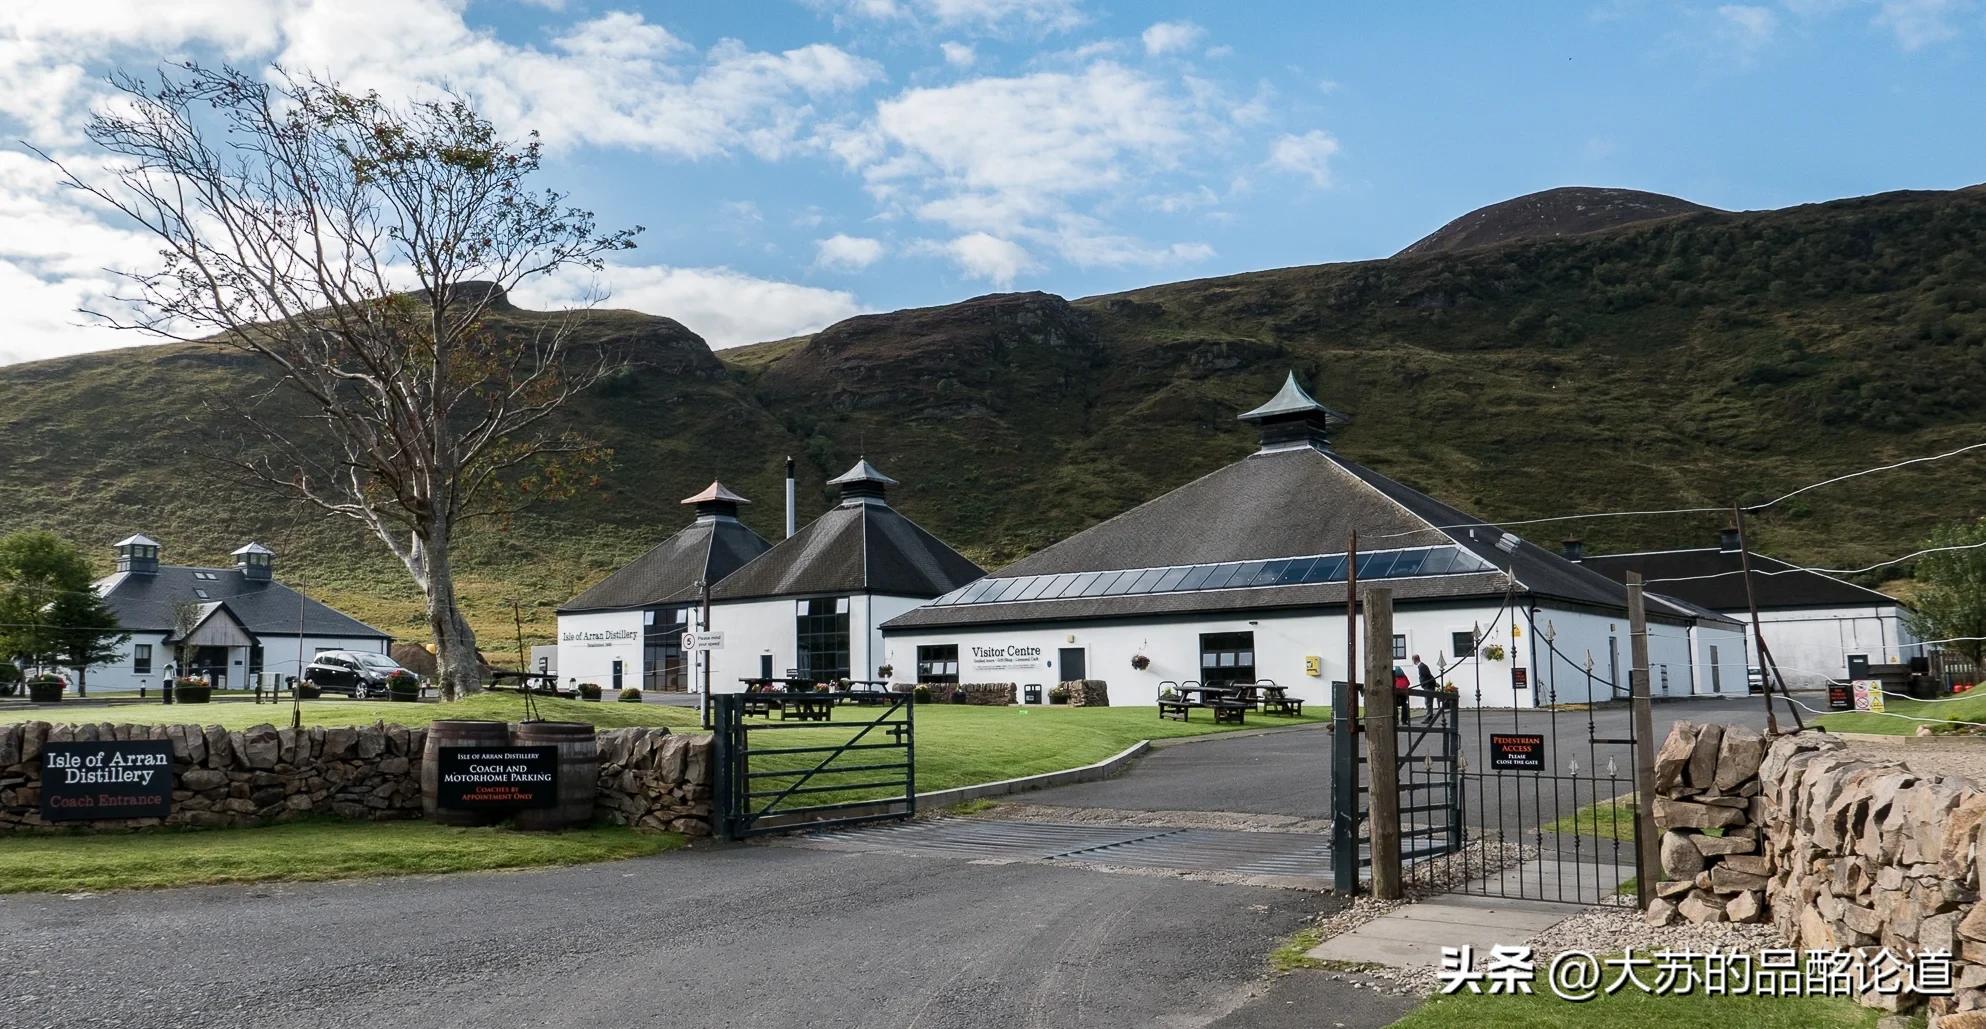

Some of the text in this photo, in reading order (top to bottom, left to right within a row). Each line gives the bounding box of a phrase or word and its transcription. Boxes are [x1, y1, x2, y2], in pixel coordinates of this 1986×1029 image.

[563, 630, 638, 641] Isle of Arran Distillery
[972, 646, 1040, 657] Visitor Centre
[47, 751, 168, 768] Isle of Arran
[64, 767, 154, 786] Distillery
[444, 773, 552, 782] MOTORHOME PARKING
[50, 793, 162, 808] Coach Entrance
[462, 793, 511, 801] APPOINTMENT
